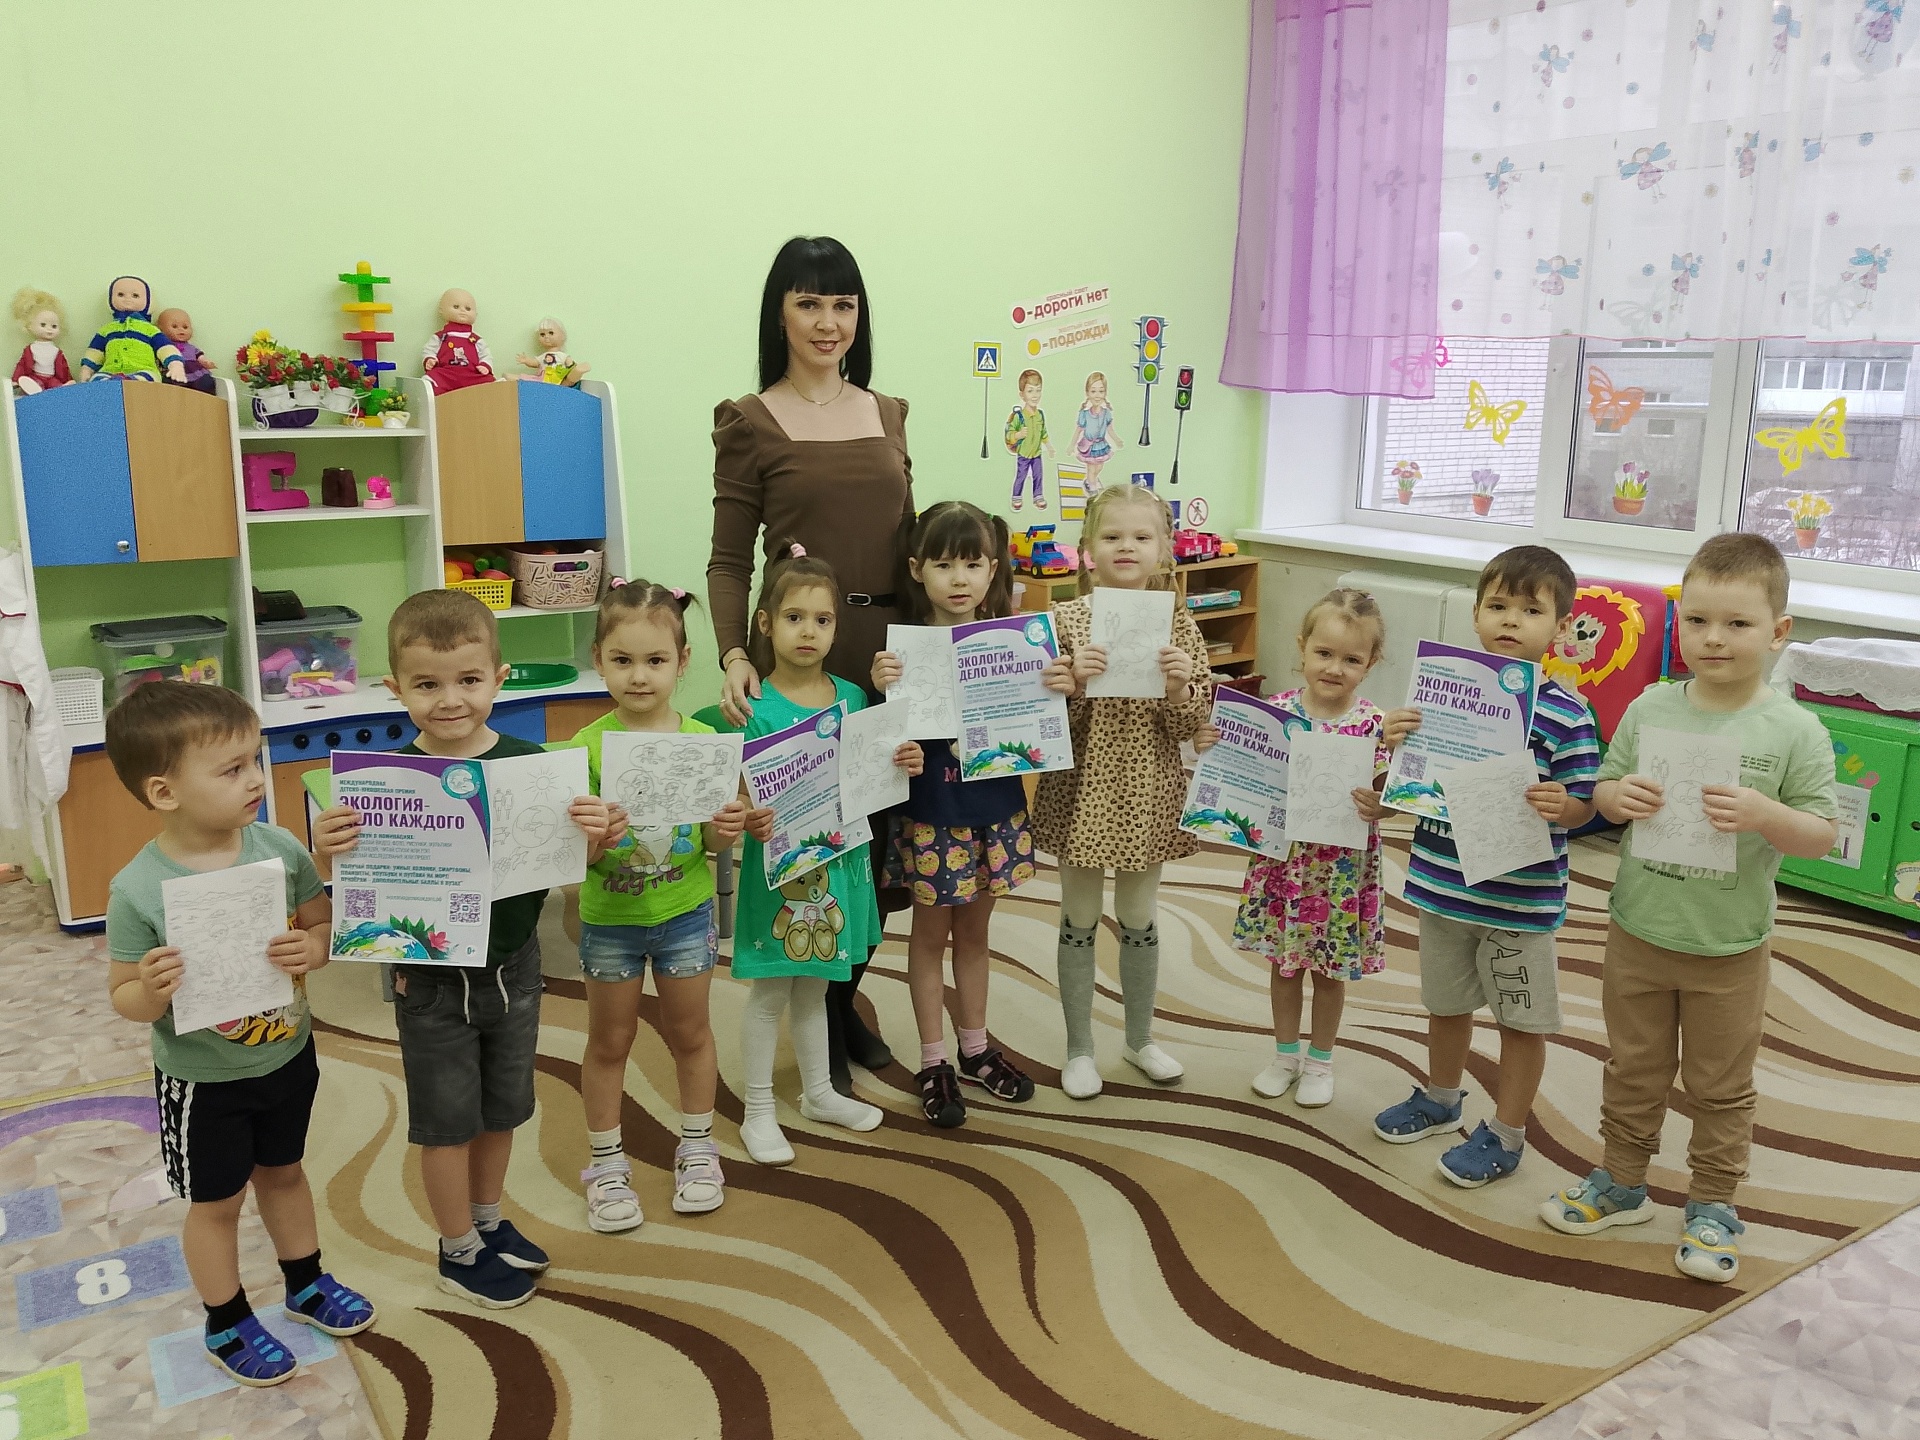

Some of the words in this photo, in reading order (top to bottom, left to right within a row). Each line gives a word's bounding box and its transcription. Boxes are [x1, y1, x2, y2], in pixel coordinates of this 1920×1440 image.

[1087, 288, 1109, 304] нет
[959, 666, 988, 683] ДЕЛО
[991, 659, 1044, 677] КАЖДОГО
[1413, 689, 1448, 707] ДЕЛО
[1451, 696, 1511, 721] КАЖДОГО
[757, 778, 788, 804] ДЕЛО
[789, 748, 835, 787] КАЖДОГО
[944, 766, 958, 783] M
[353, 812, 384, 827] ЛО
[389, 813, 465, 831] КАЖДОГО
[1656, 870, 1686, 882] PREDATOR
[466, 945, 475, 955] 0+
[75, 1258, 132, 1306] 8
